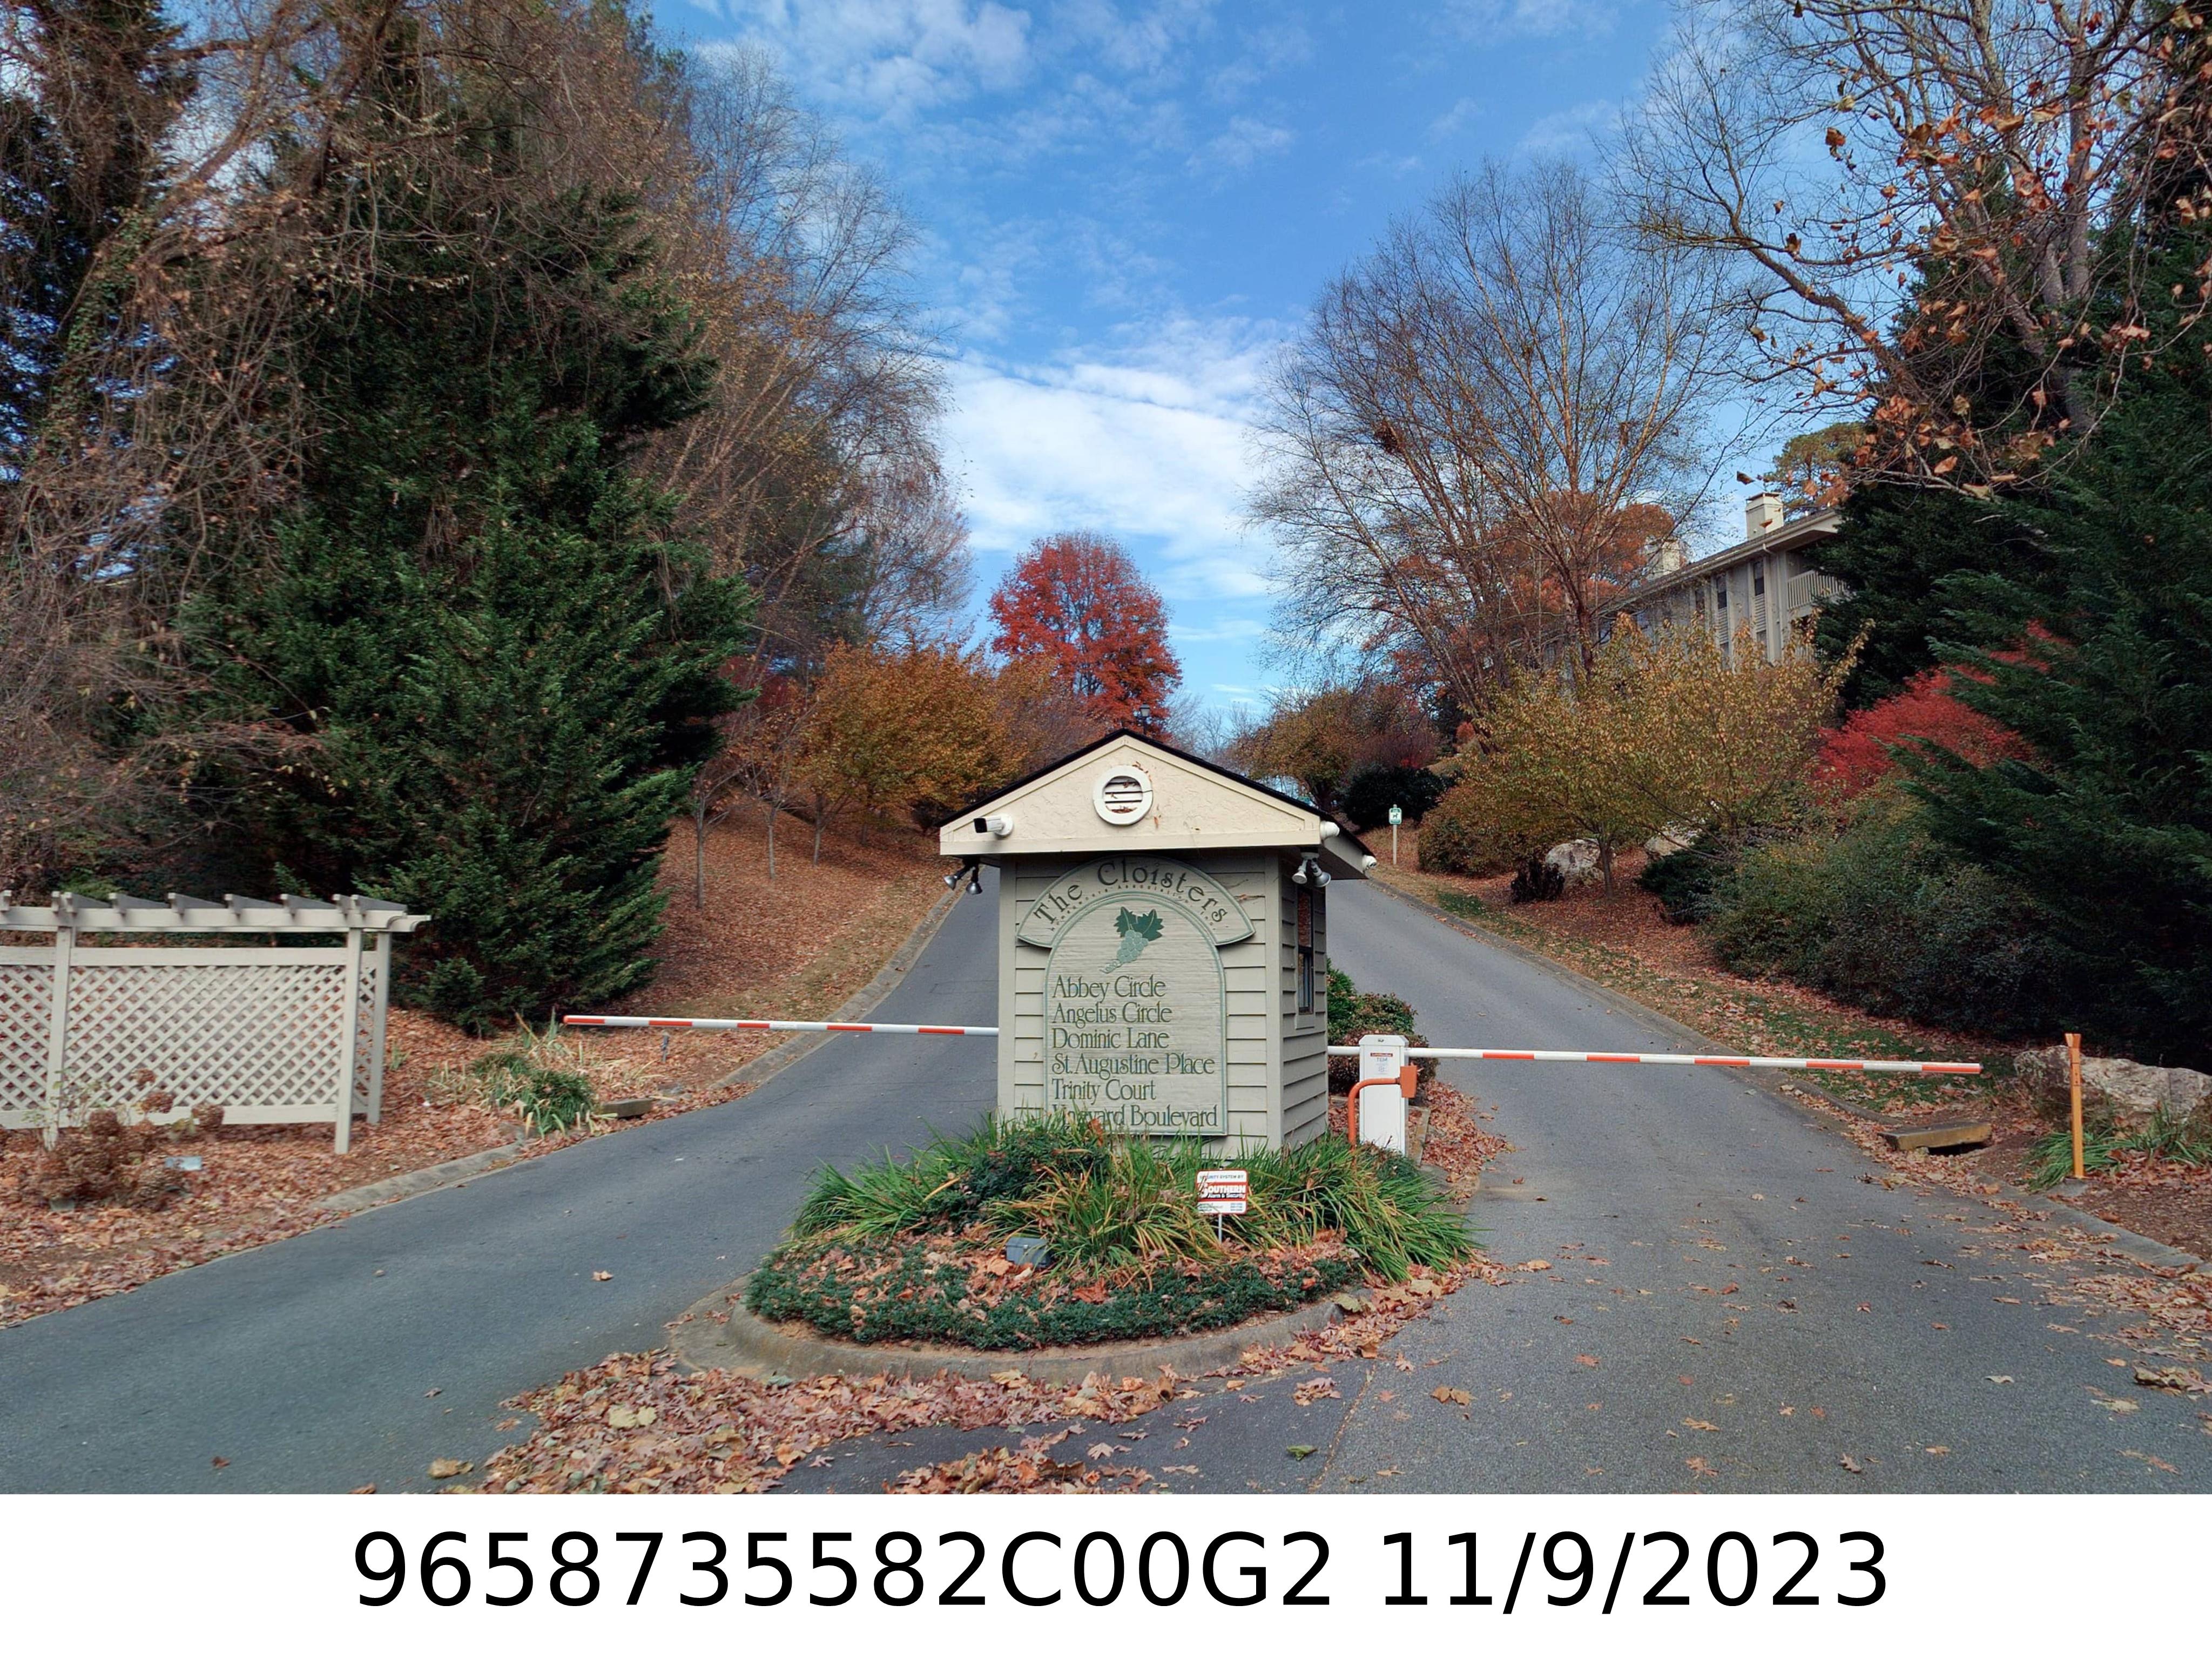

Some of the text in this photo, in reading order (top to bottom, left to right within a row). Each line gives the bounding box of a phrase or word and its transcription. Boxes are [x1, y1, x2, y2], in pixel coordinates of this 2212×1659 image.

[1033, 857, 1229, 925] The Cloisters
[1052, 974, 1166, 1003] Abbey Circle
[1052, 1000, 1173, 1029] Angelus Circle
[1052, 1027, 1170, 1049] Dominic Lane
[1165, 1052, 1215, 1075] Place
[1052, 1078, 1157, 1105] Trinity Court
[1130, 1103, 1218, 1127] Boulevard
